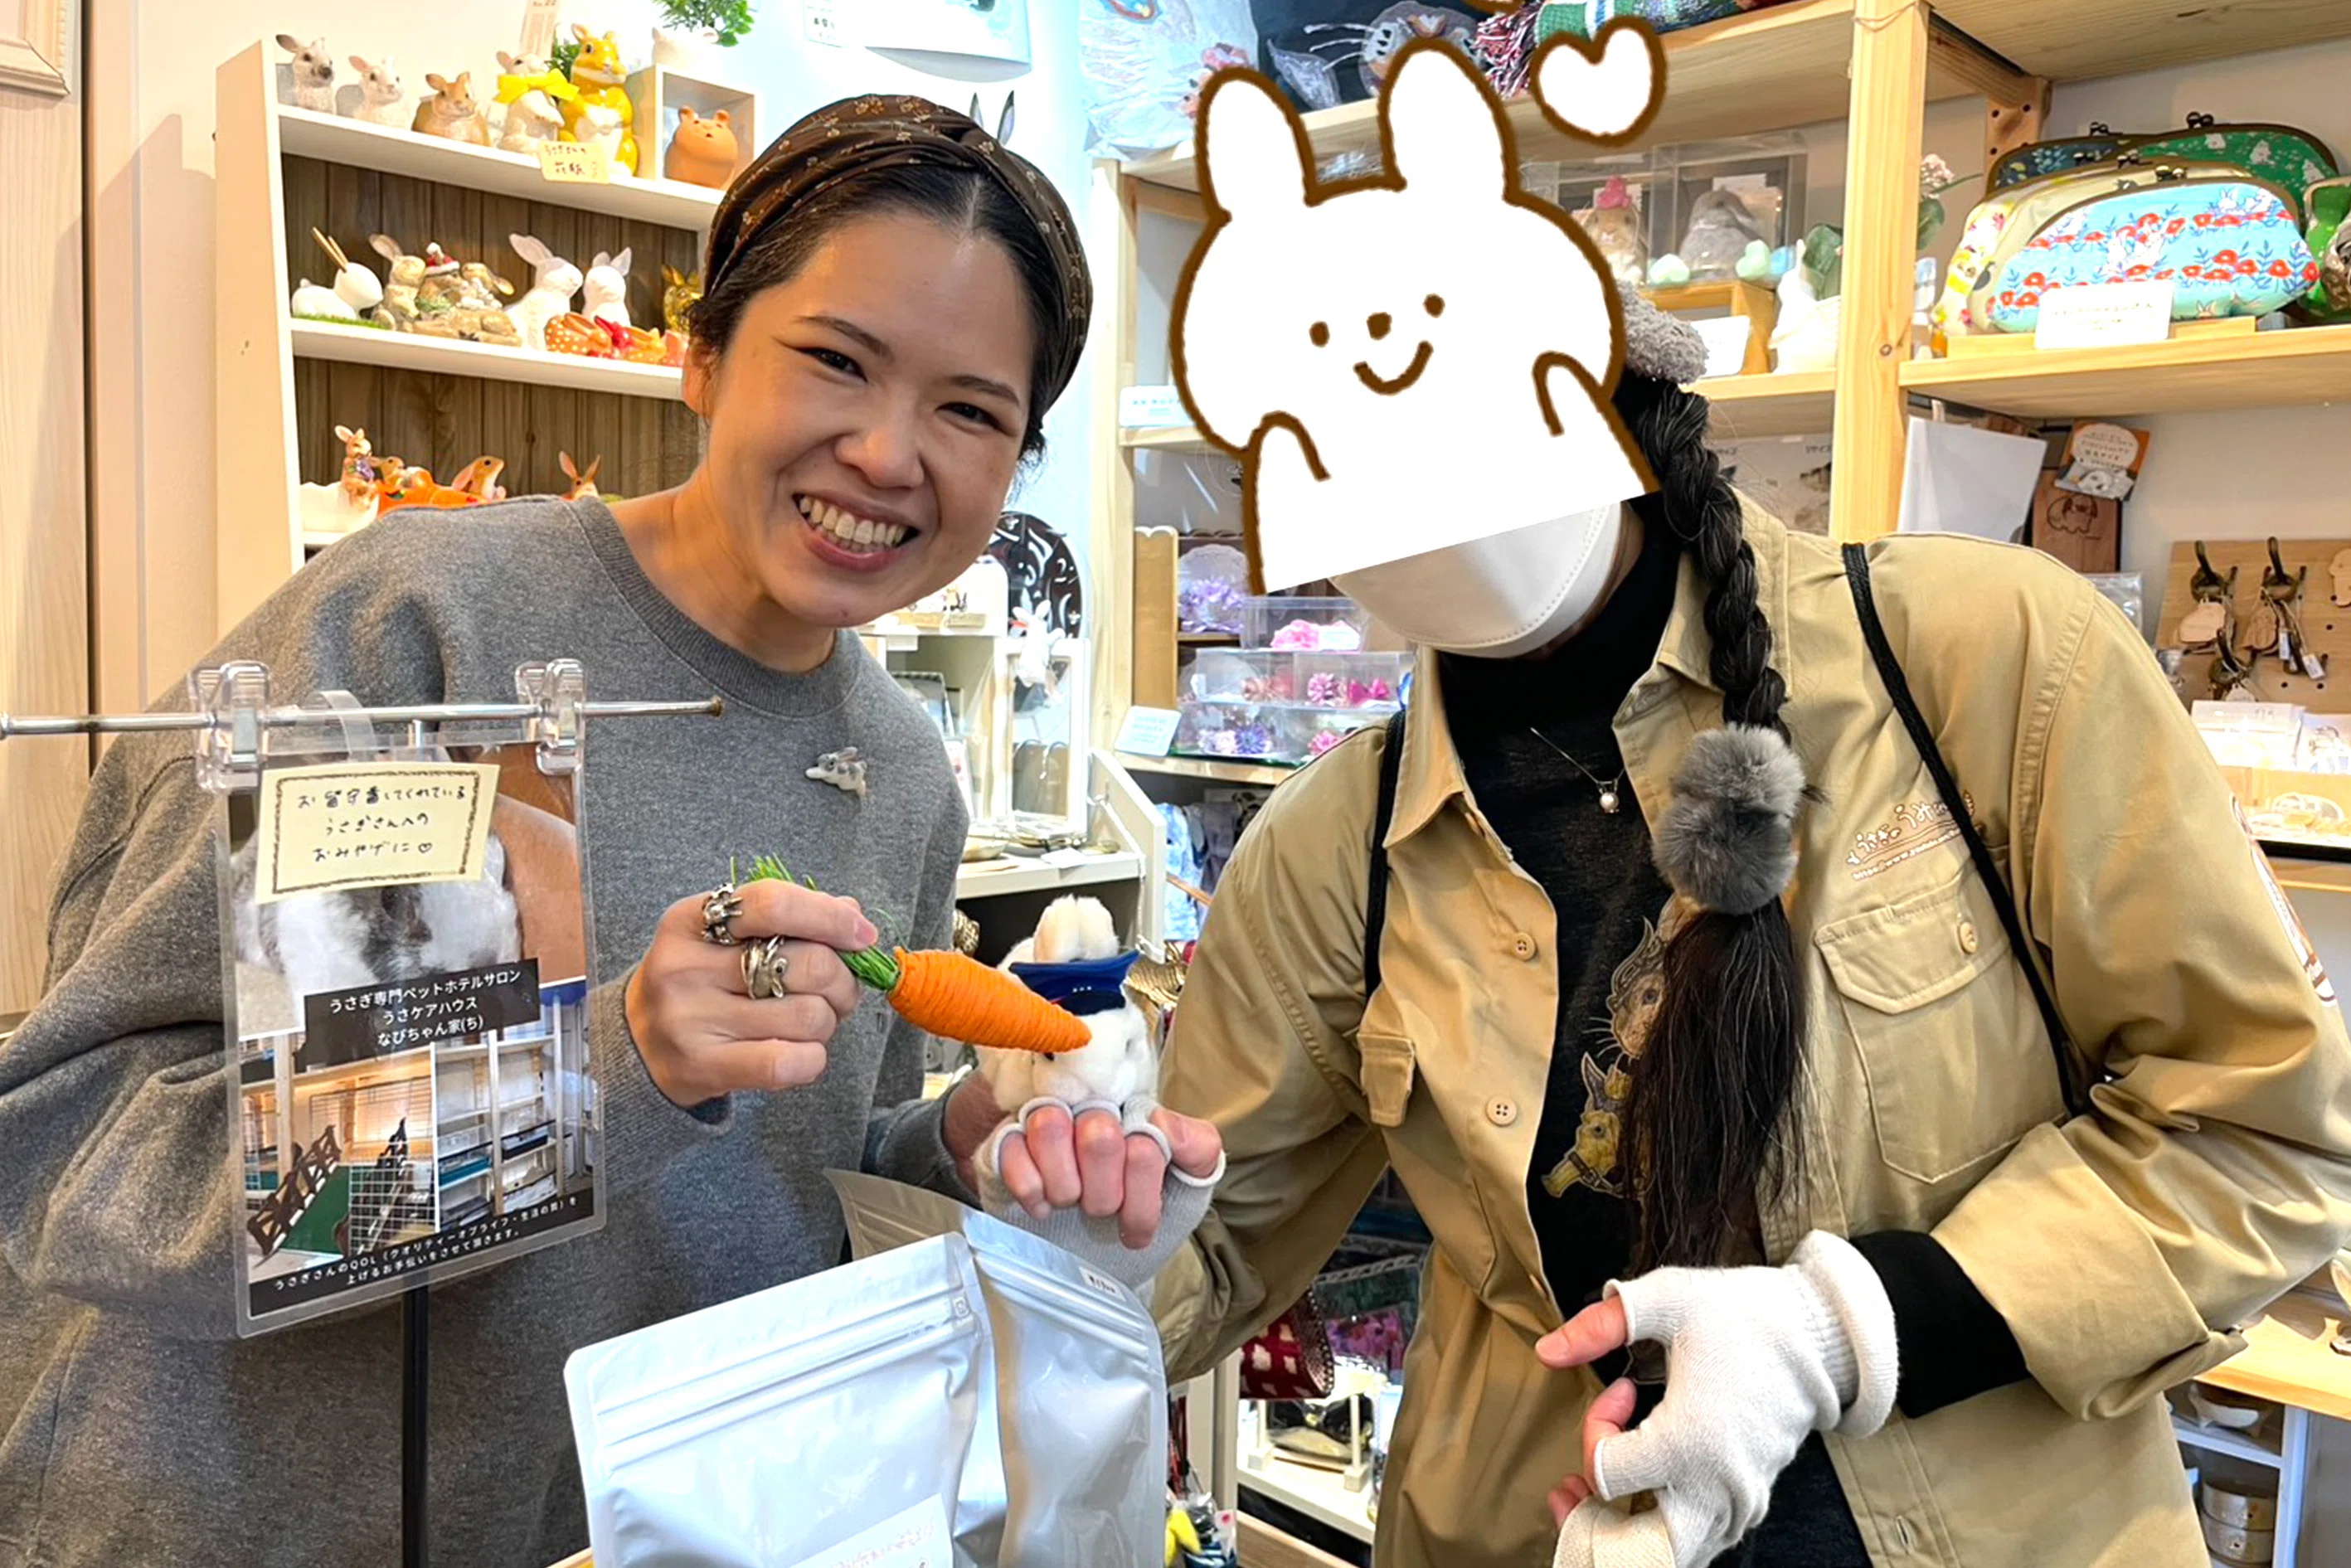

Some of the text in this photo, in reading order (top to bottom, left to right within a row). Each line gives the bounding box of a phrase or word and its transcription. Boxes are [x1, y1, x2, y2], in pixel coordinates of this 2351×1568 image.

[298, 786, 466, 808] お留守番してくれている
[326, 813, 429, 835] うさぎさんへの
[329, 970, 522, 1013] うさぎ専門ペットホテルサロン
[382, 997, 478, 1025] うさケアハウス
[378, 1015, 483, 1046] なびちゃん家(ち)
